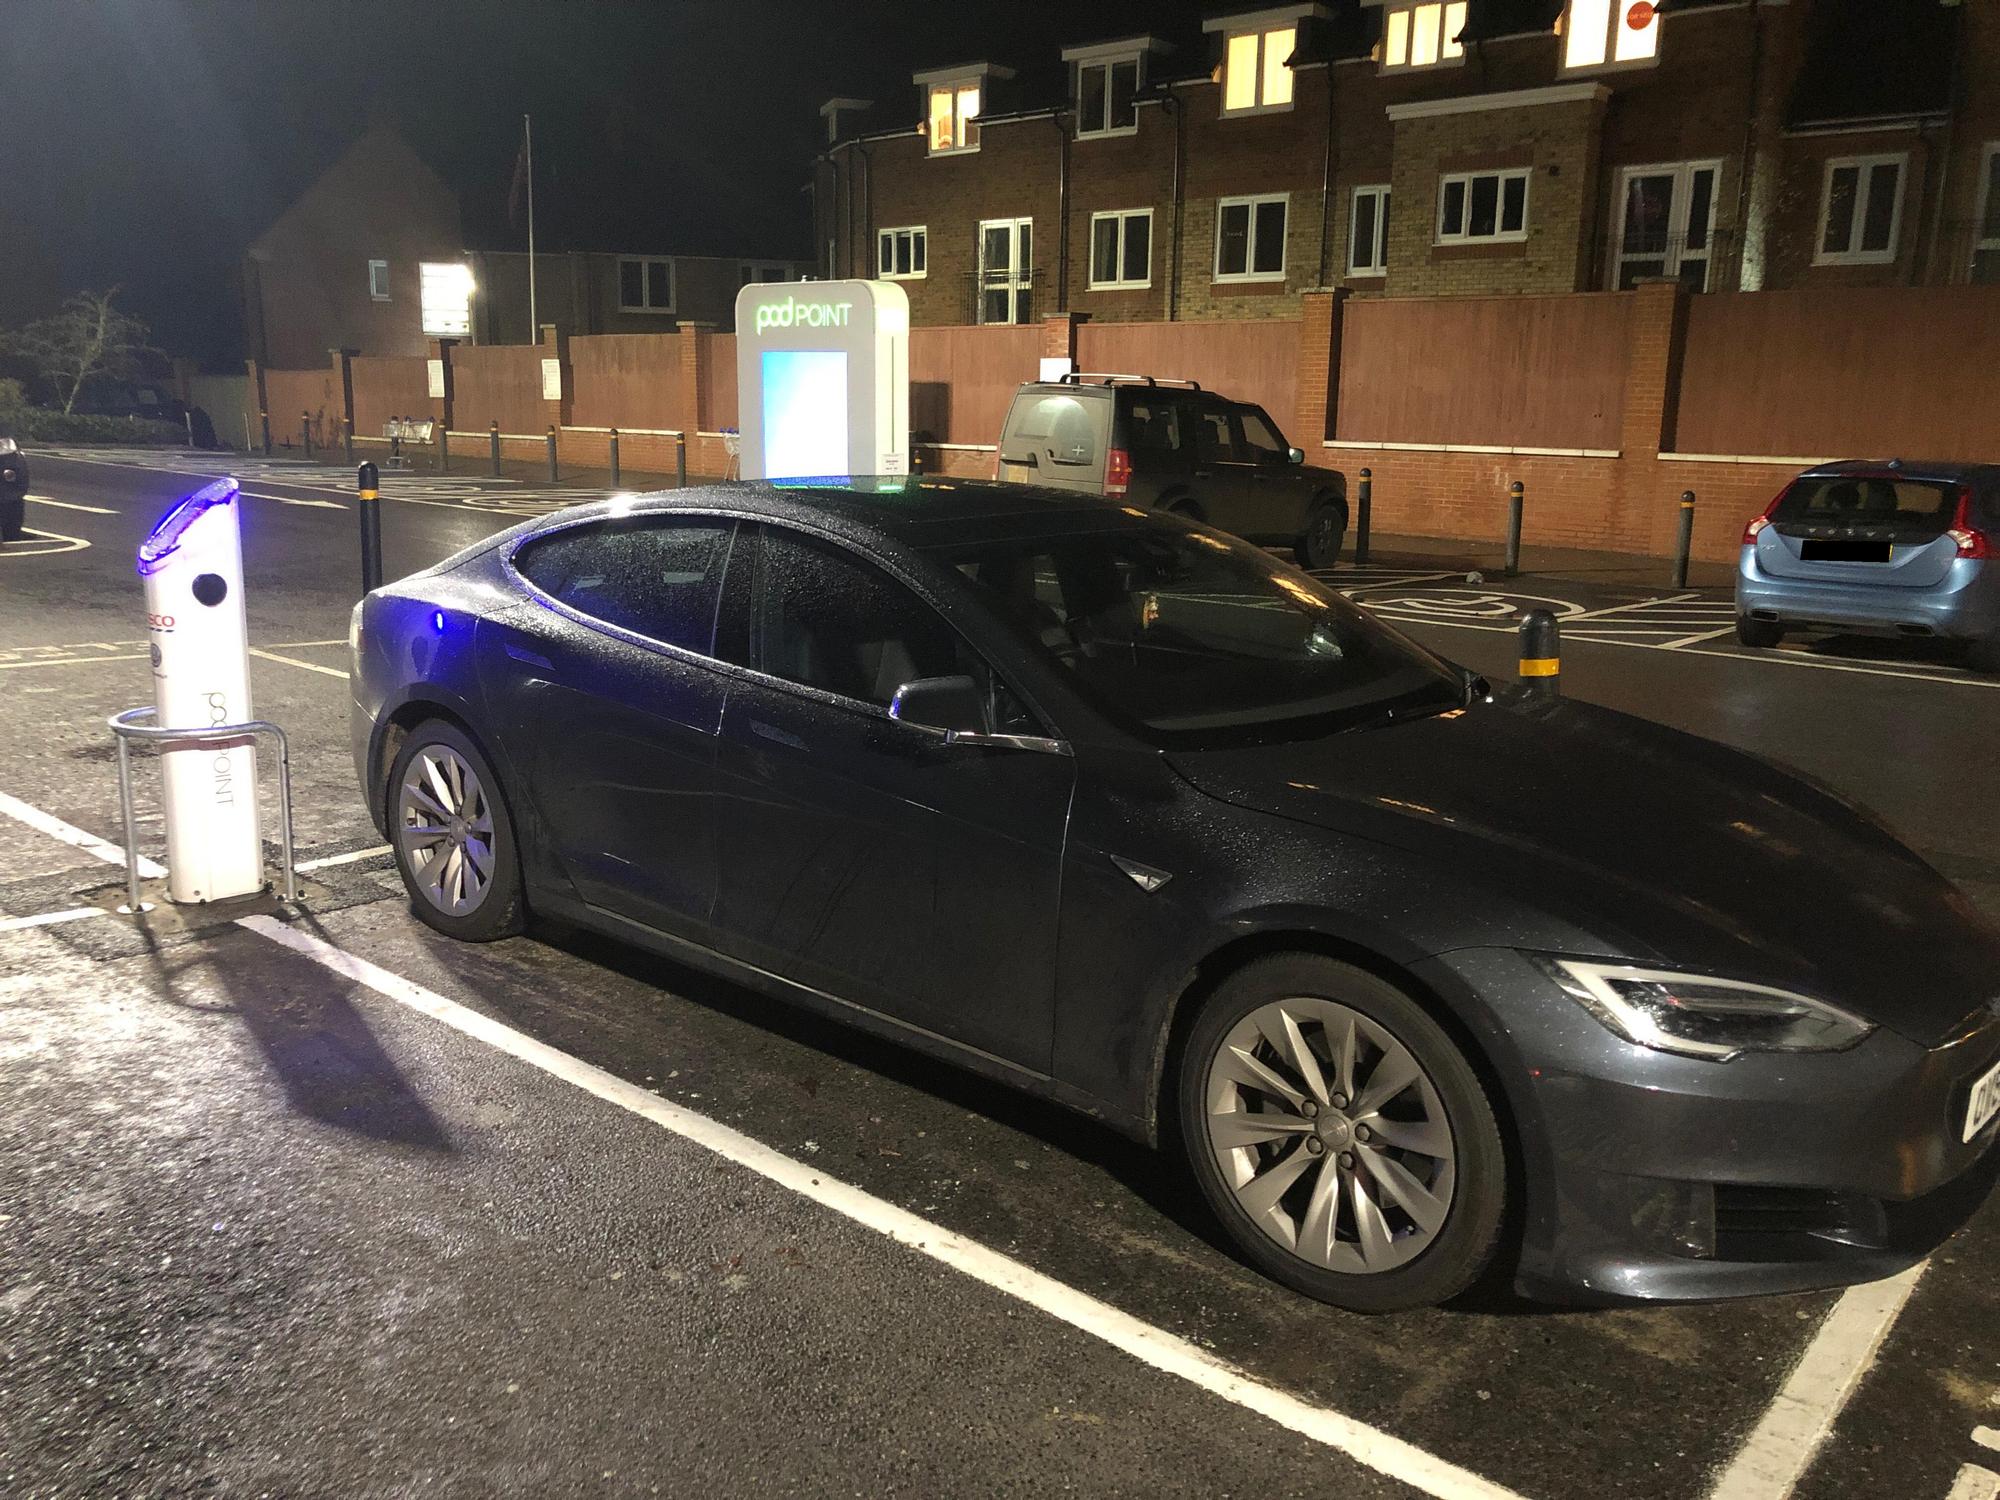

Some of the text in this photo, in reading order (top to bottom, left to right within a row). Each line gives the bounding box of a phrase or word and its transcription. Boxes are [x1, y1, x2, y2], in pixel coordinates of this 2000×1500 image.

[757, 295, 853, 336] pod POINT
[145, 612, 175, 627] SCO
[212, 741, 234, 807] POINT
